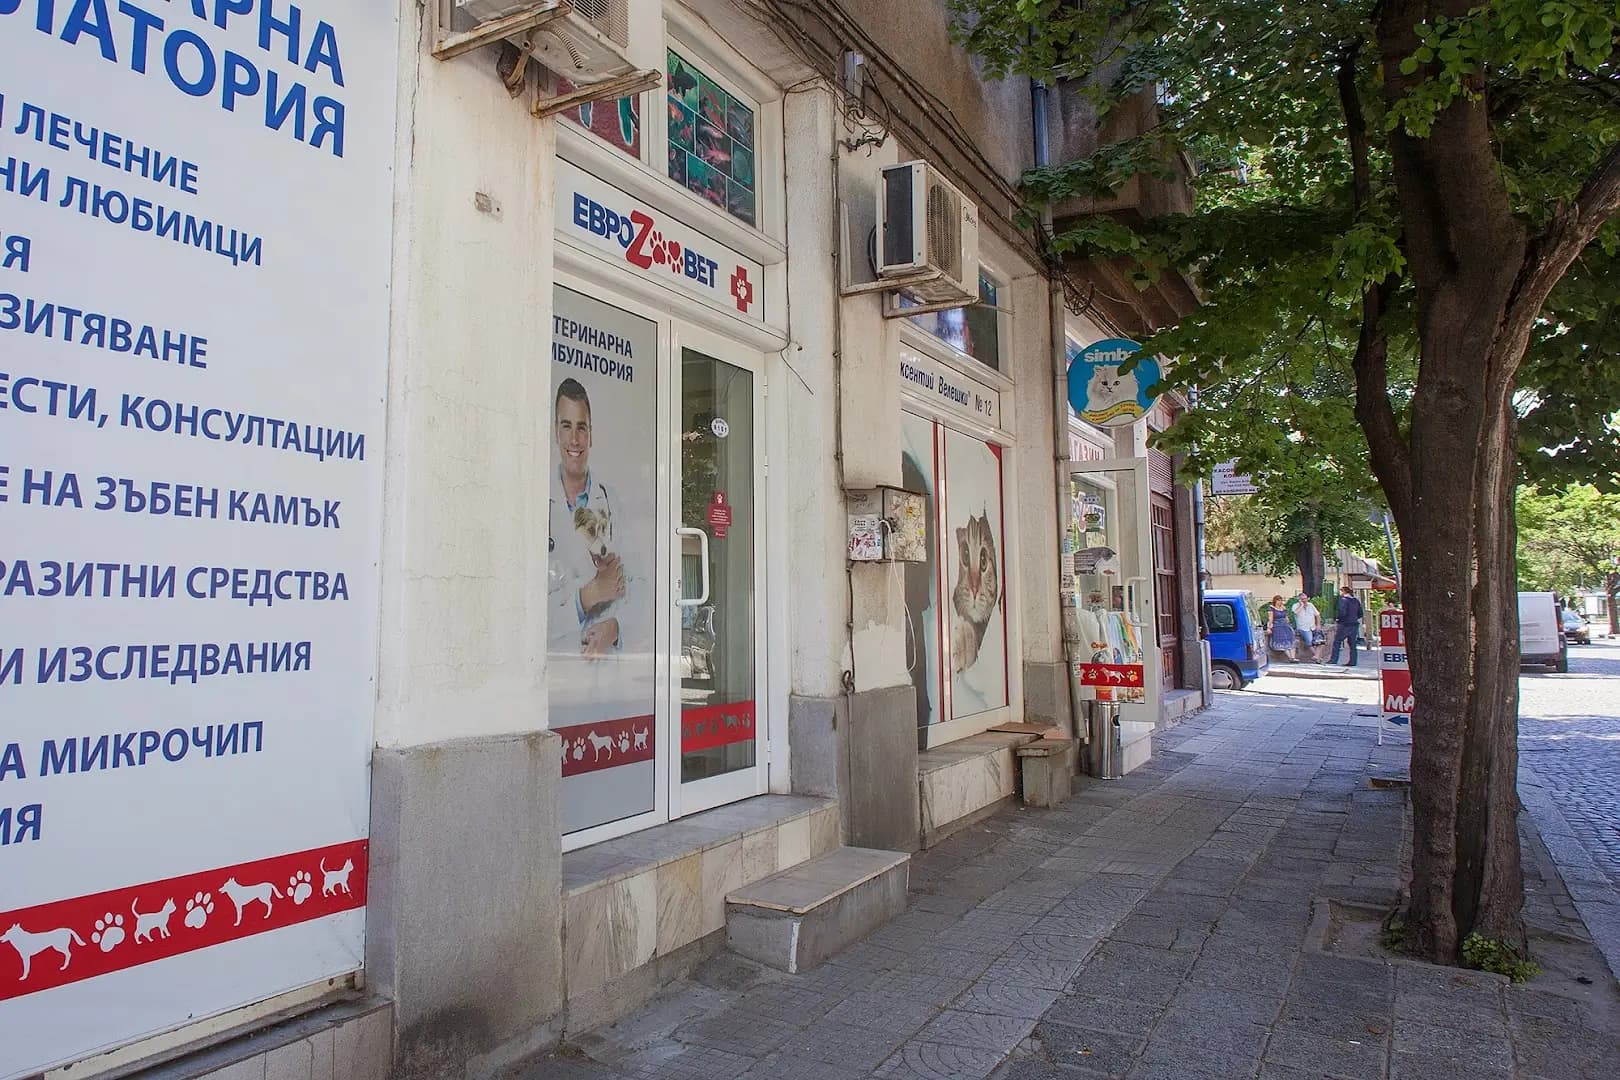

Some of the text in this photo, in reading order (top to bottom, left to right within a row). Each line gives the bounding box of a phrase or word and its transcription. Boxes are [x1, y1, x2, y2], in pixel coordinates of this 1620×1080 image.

[14, 101, 199, 195] ЛЕЧЕНИЕ
[59, 175, 262, 266] ЛЮБИМЦИ
[0, 291, 208, 369] ЗИТЯВАНЕ
[552, 314, 633, 359] ТЕРИНАРНА
[118, 393, 365, 462] КОНСУЛТАЦИИ
[22, 468, 82, 508] НА
[94, 476, 218, 519] ЗЪБЕН
[228, 491, 341, 529] КАМЪК
[186, 566, 350, 607] СРЕДСТВА
[37, 641, 312, 685] ИЗСЛЕДВАНИЯ
[39, 721, 264, 778] МИКРОЧИП
